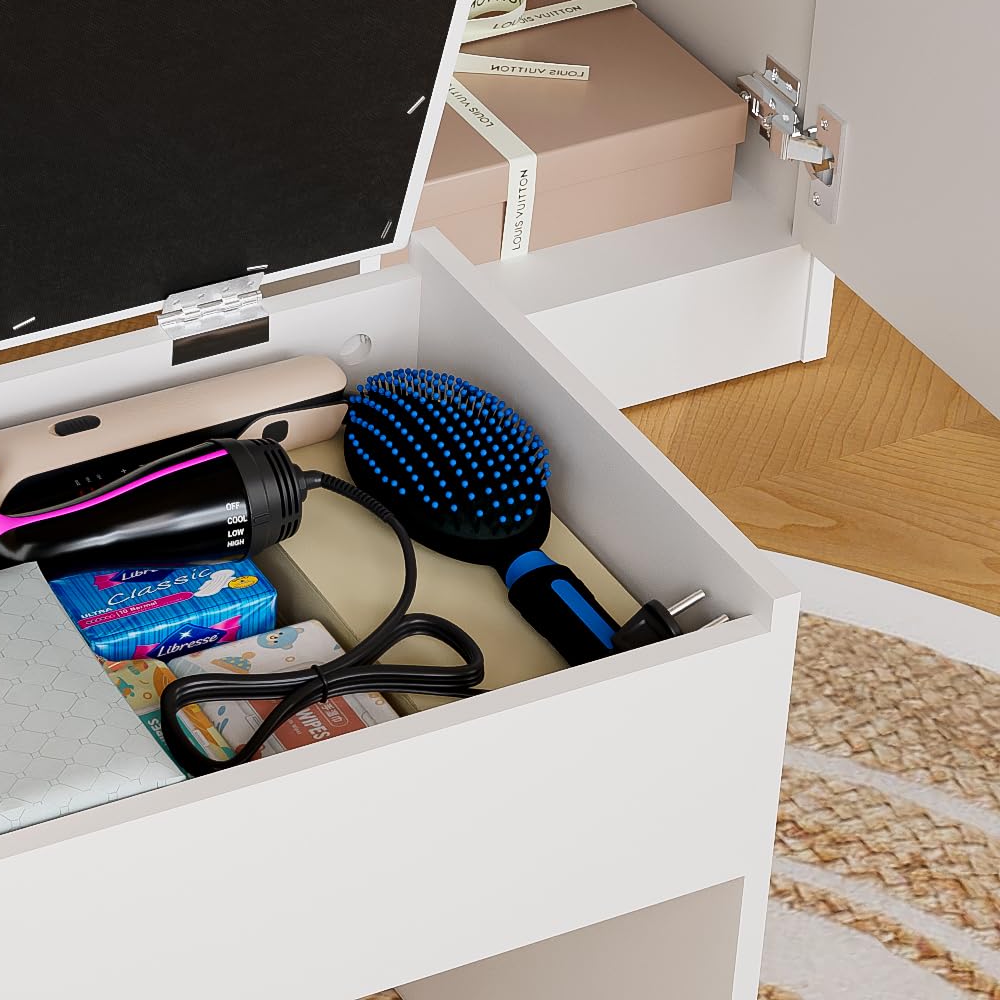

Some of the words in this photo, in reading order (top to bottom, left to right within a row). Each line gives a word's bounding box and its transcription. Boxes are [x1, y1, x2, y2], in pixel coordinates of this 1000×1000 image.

[535, 5, 582, 19] VUITTON
[448, 83, 469, 108] VUITT
[469, 107, 494, 128] LOUIS
[516, 169, 528, 219] VUITTON
[512, 220, 524, 250] LOUIS
[226, 501, 240, 511] OFF
[227, 515, 248, 525] COOL
[227, 528, 245, 538] LOW
[227, 538, 245, 548] HIGH
[107, 568, 212, 607] Classic
[81, 607, 113, 619] ULTRA
[130, 601, 158, 613] Normal
[157, 633, 219, 658] Libresse
[296, 707, 330, 740] WIPES
